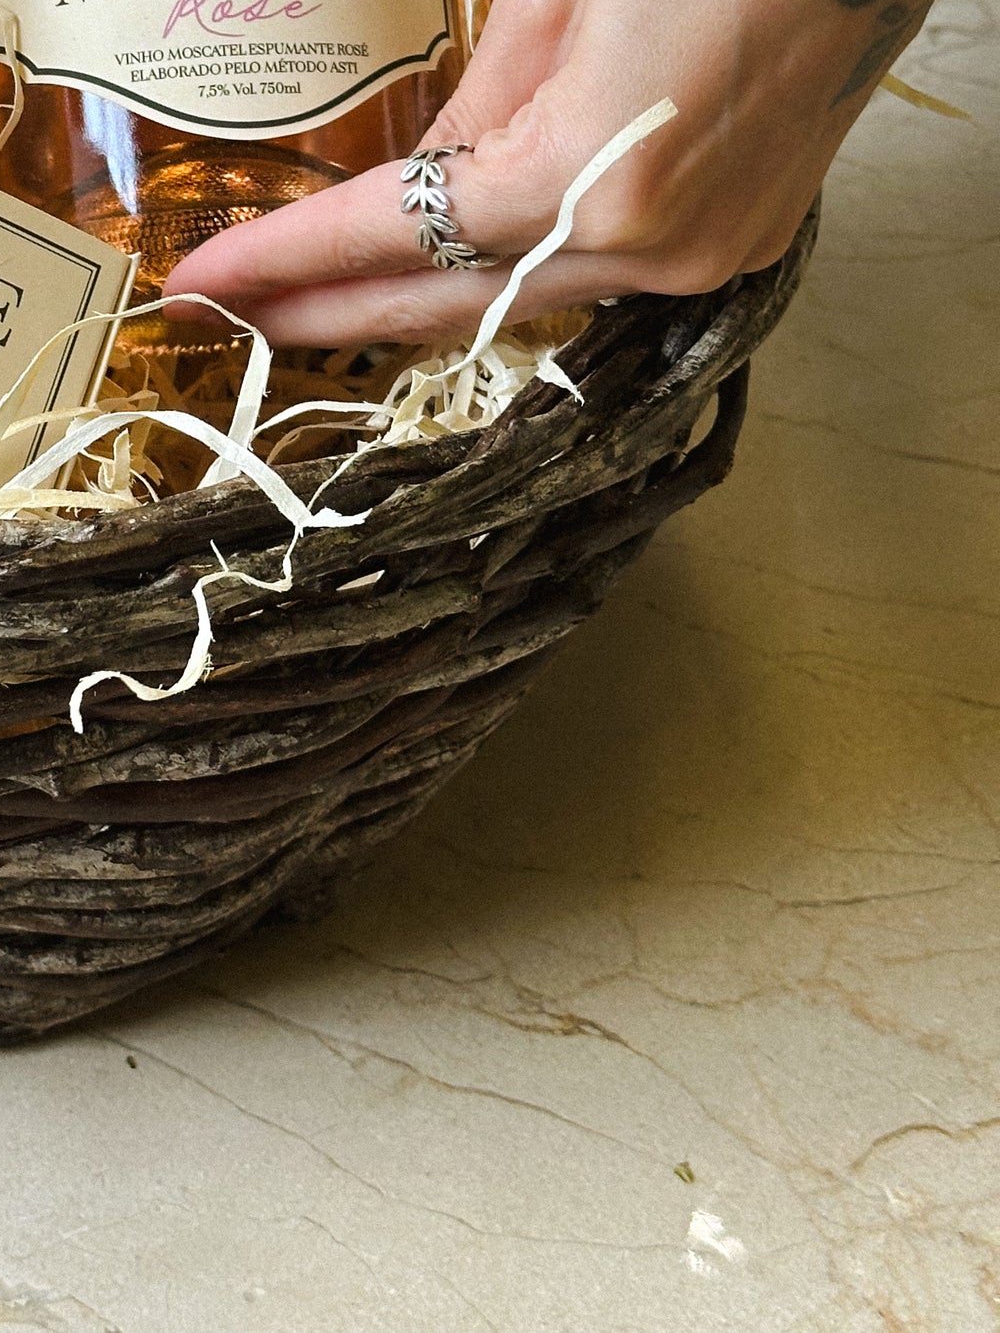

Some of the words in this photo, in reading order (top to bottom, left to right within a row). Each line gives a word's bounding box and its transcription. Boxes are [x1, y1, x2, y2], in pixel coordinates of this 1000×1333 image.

[115, 49, 164, 65] VINHO
[168, 44, 247, 60] MOSCATEL
[248, 42, 335, 55] ESPUMANTE
[337, 42, 369, 57] ROSÉ
[131, 63, 221, 83] ELABORADO
[225, 61, 260, 75] PELO
[264, 58, 327, 73] MÉTODO
[330, 61, 358, 74] ASTI
[198, 83, 230, 98] 7,5%
[260, 82, 302, 95] 750ml
